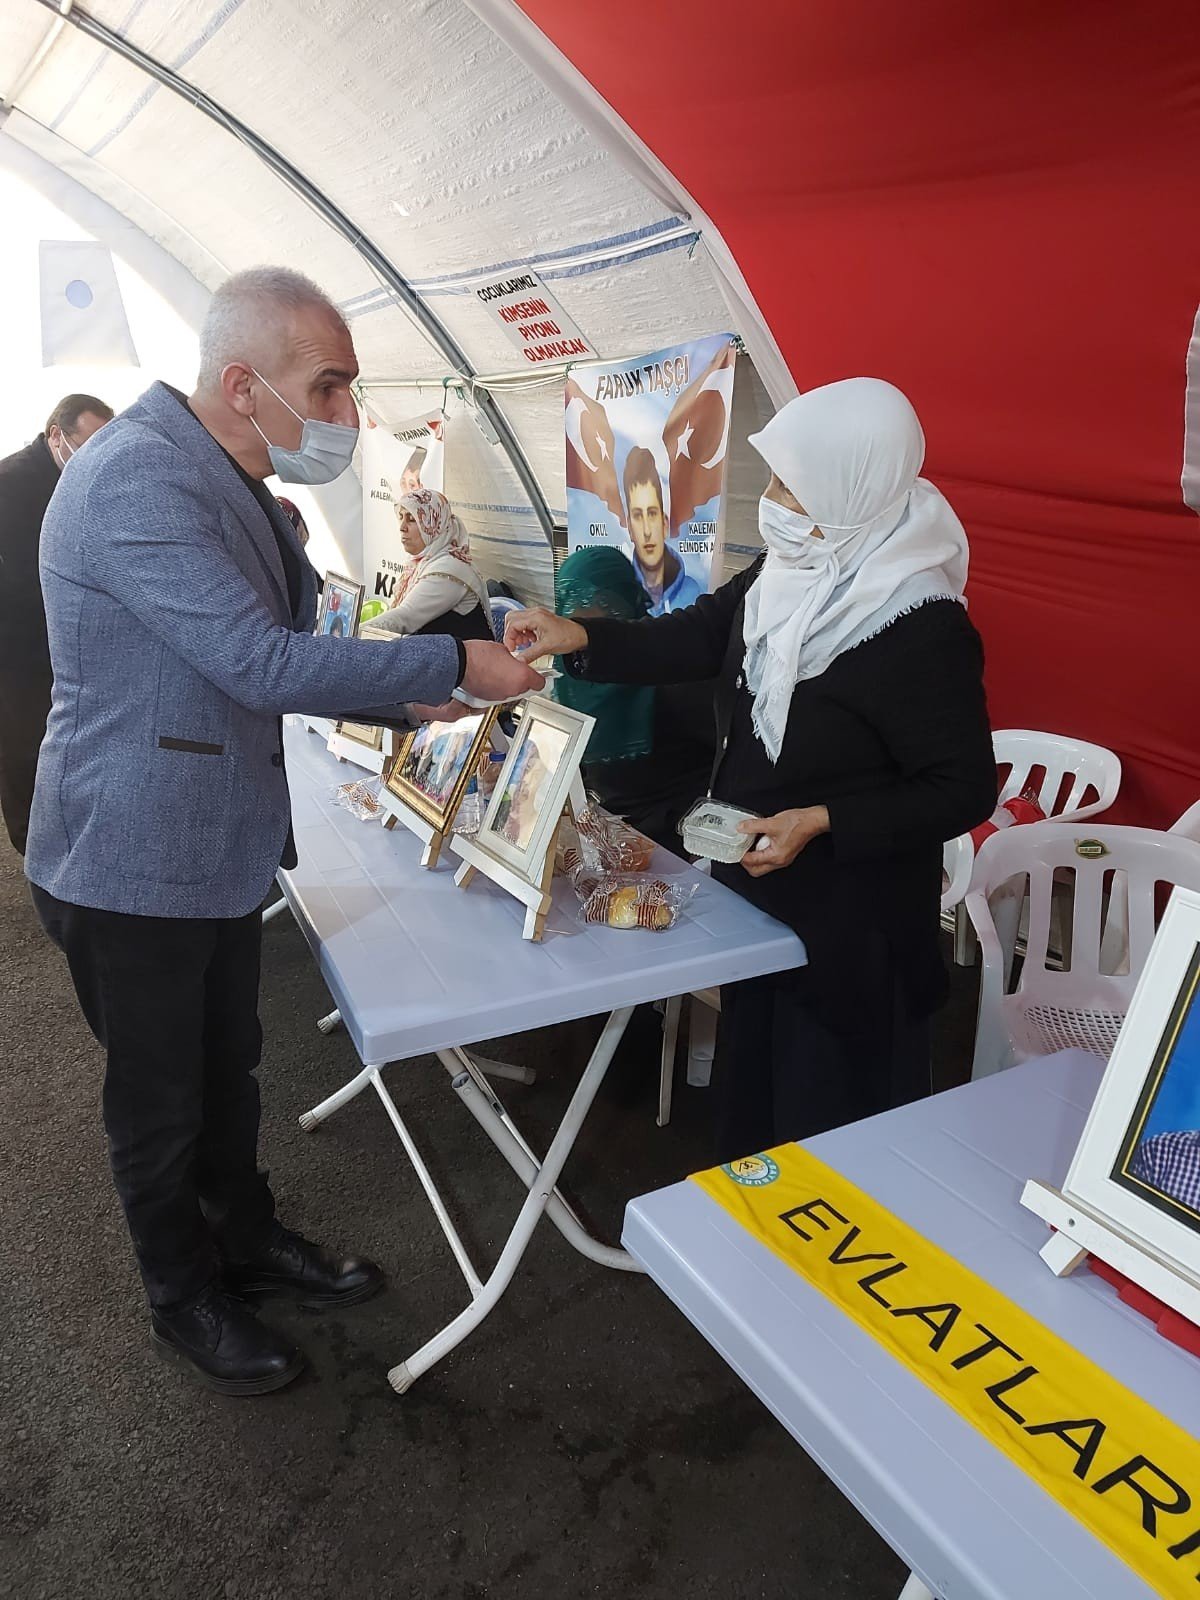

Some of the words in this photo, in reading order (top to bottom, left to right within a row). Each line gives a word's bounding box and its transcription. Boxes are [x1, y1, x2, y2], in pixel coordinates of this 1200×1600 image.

[477, 275, 538, 303] ÇOCUKLARIMIZ
[497, 297, 552, 324] KİMSENİN
[518, 320, 561, 341] PİYONU
[523, 338, 590, 362] OLMAYACAK
[595, 369, 644, 400] FARUK
[643, 354, 690, 397] TAŞÇI
[589, 523, 608, 537] OKUL
